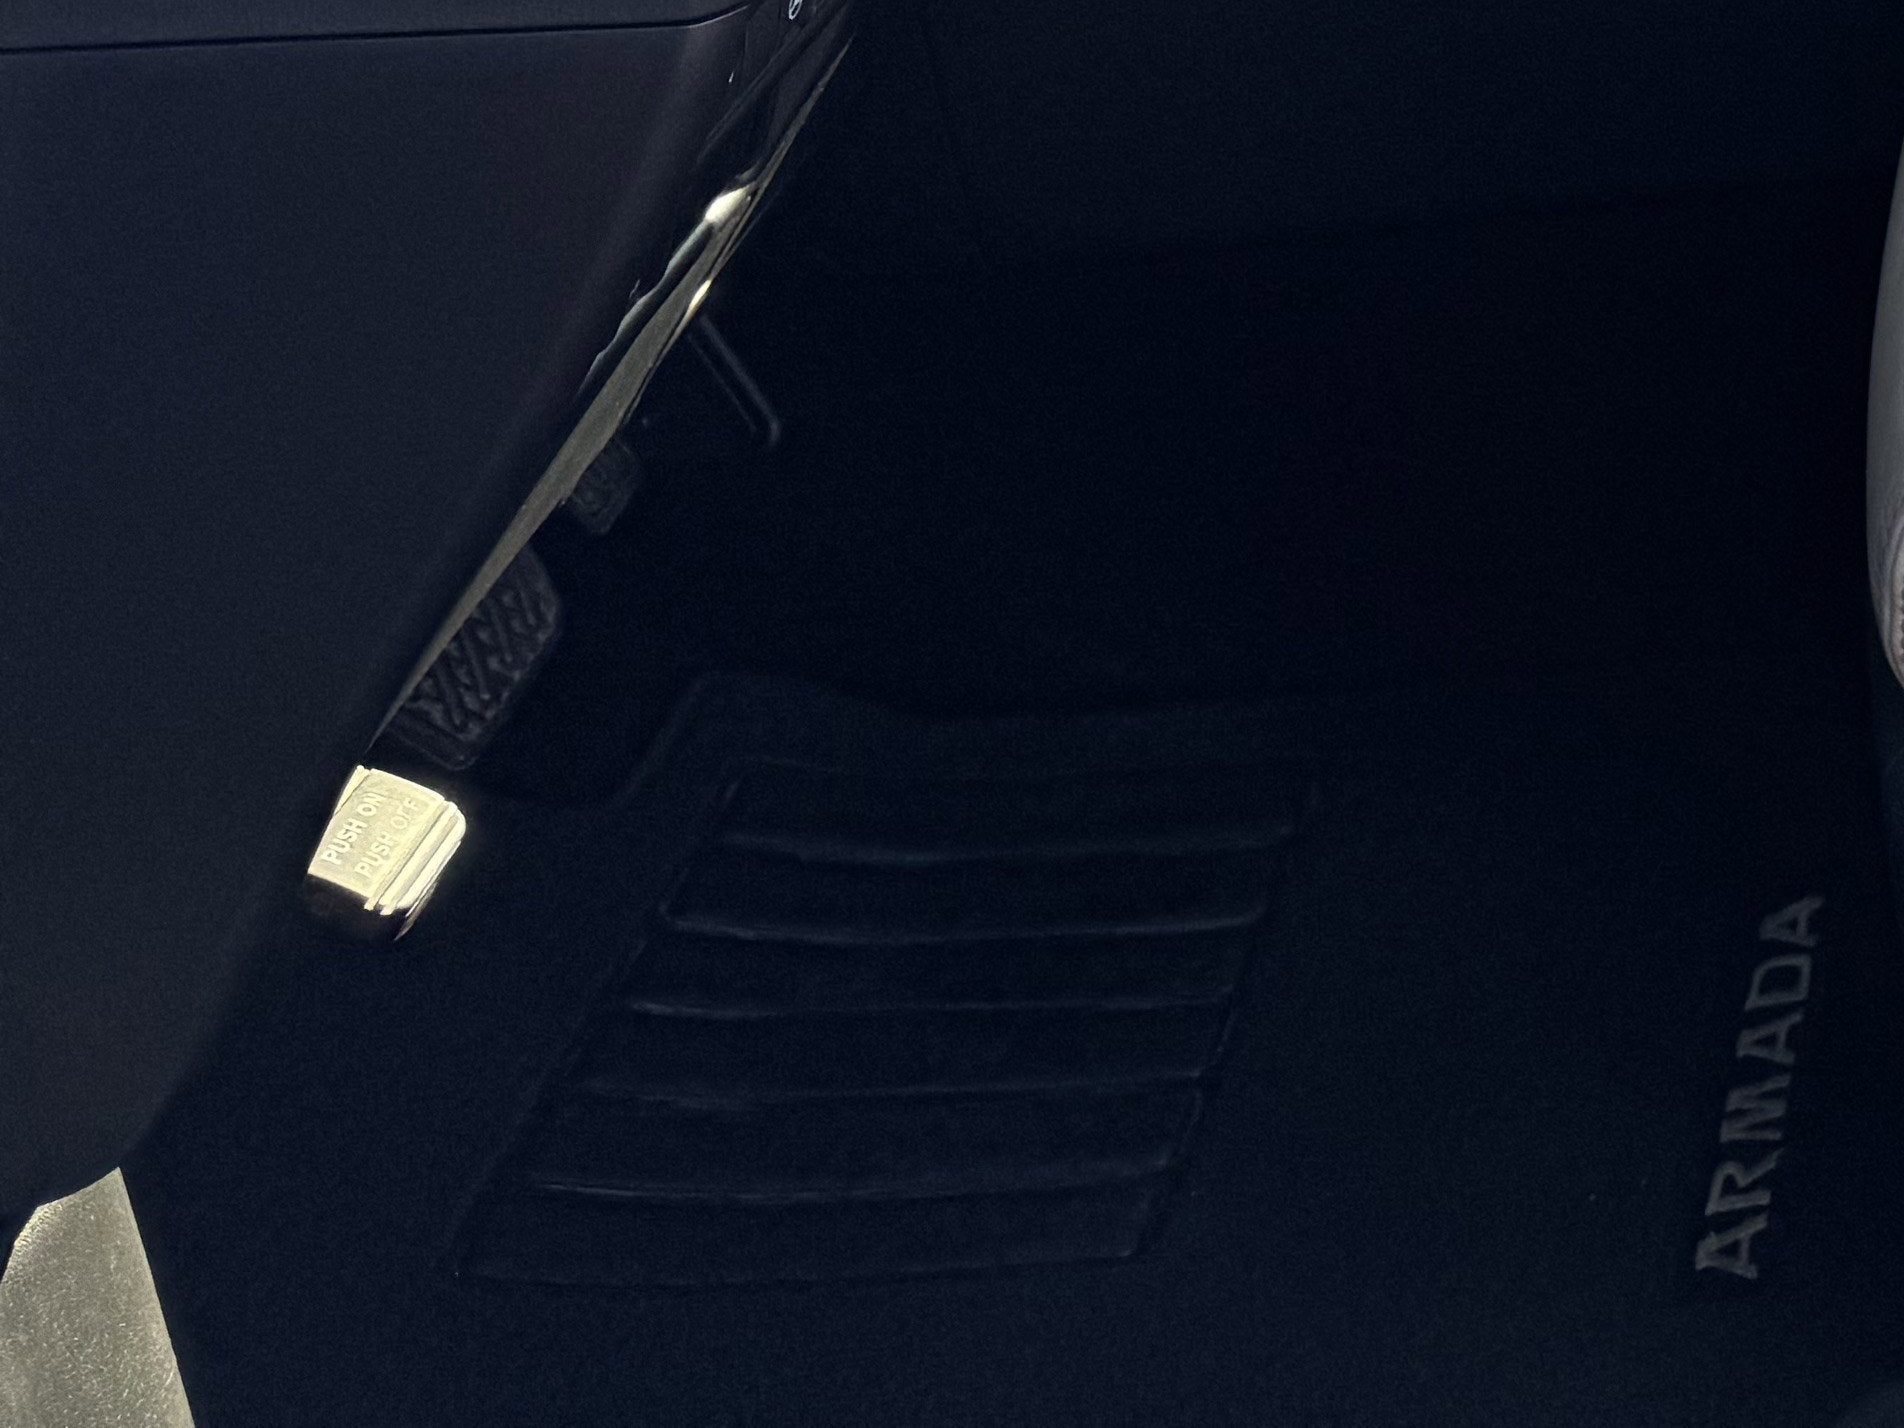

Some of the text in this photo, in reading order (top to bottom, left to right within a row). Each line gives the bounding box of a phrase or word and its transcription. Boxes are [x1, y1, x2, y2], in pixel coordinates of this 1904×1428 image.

[321, 792, 385, 865] PUSH ON
[355, 797, 421, 878] PUSH OFF
[1695, 892, 1826, 1280] ARMADA
